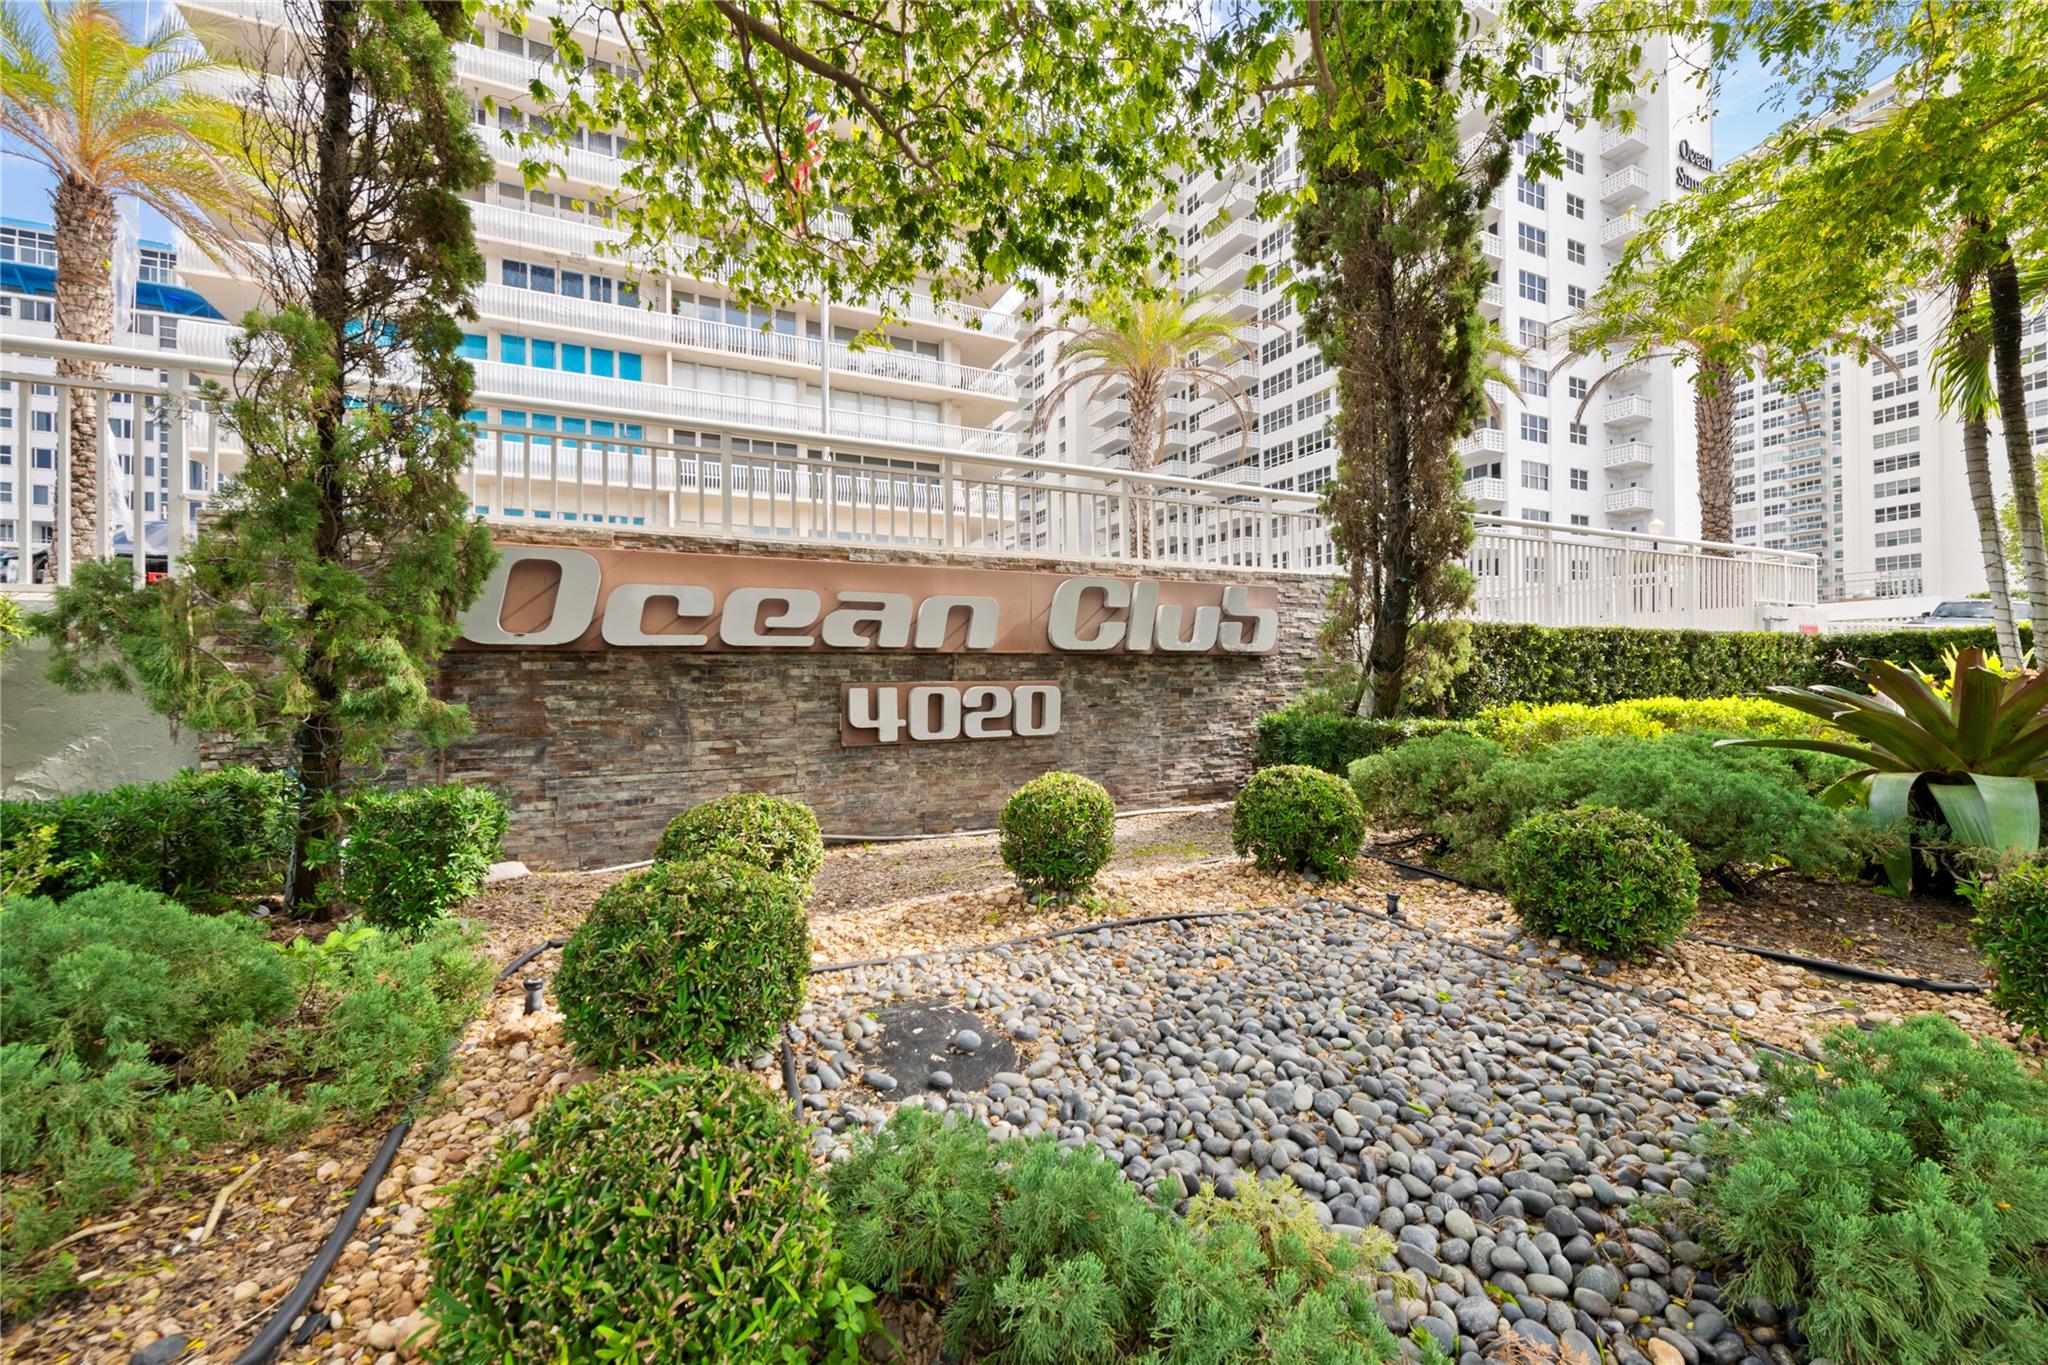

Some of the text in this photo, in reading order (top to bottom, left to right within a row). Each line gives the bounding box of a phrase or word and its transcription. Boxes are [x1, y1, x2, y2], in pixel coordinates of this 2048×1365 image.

[1679, 139, 1712, 172] Ocean
[457, 545, 1278, 653] Ocean Club
[848, 684, 1061, 743] 4020
